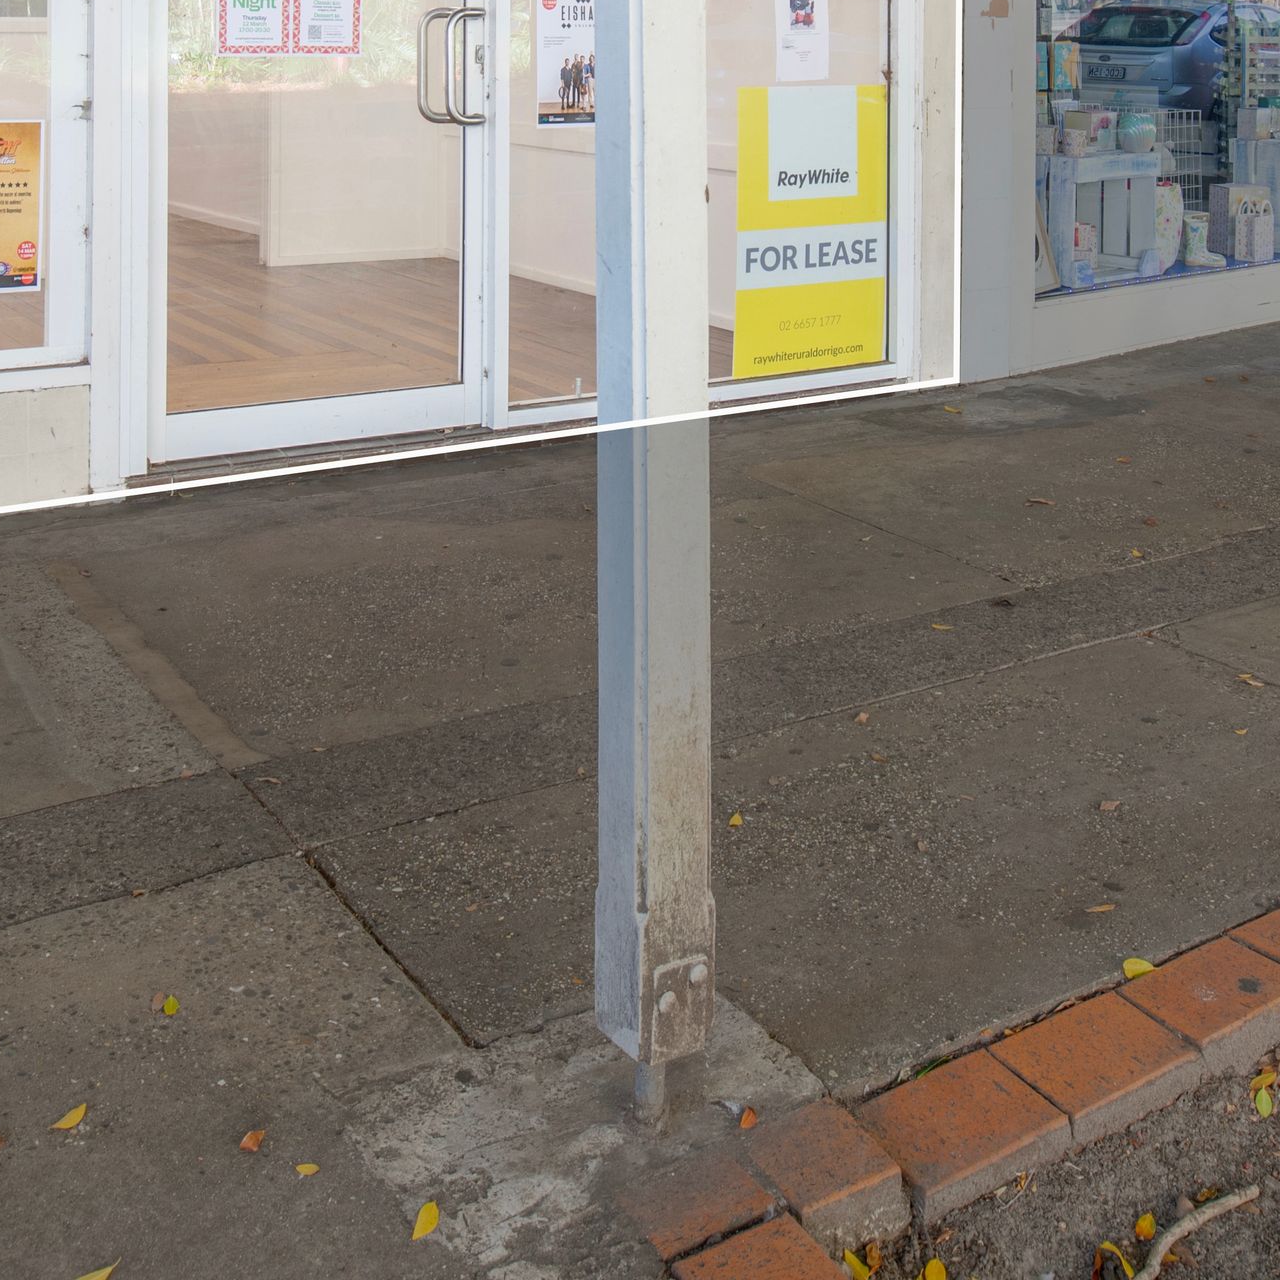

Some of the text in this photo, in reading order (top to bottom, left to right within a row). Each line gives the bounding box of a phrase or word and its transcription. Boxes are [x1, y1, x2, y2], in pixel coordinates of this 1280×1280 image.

[777, 167, 850, 189] RayWhite
[745, 238, 878, 274] FOR LEASE
[778, 314, 842, 332] 02 6657 1777
[753, 342, 864, 365] raywhiteruraldorrigo.com
